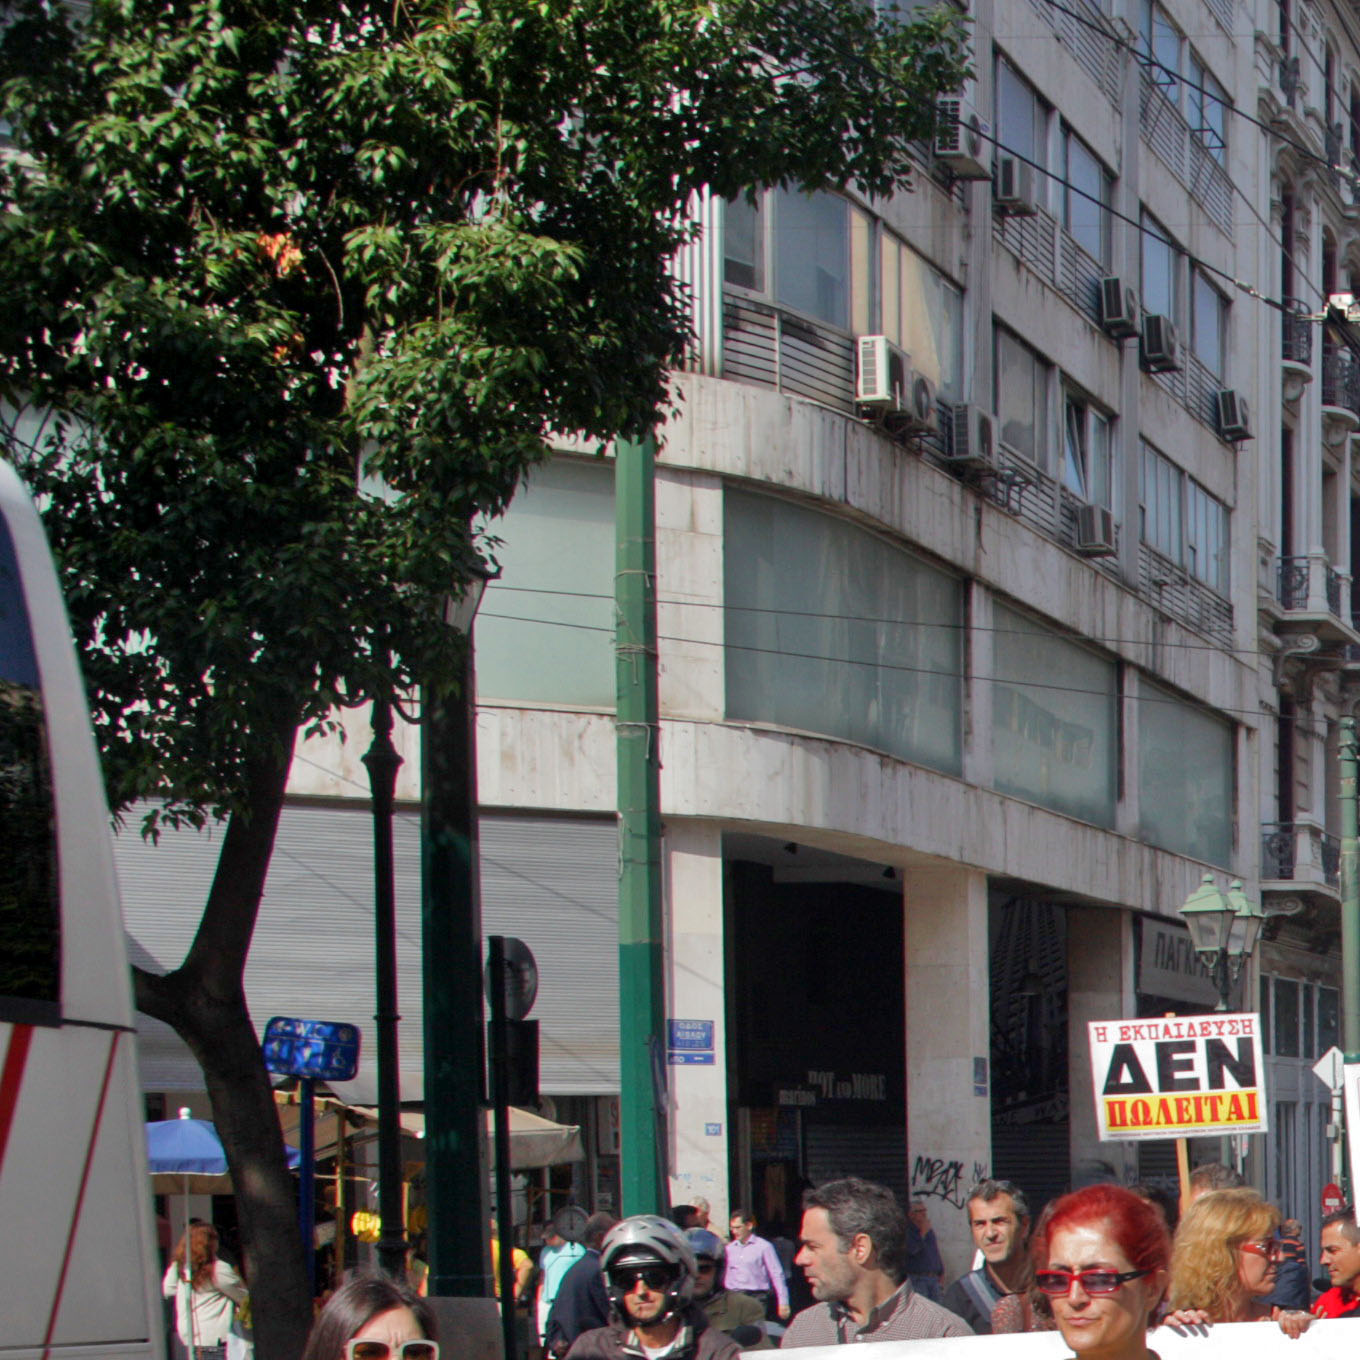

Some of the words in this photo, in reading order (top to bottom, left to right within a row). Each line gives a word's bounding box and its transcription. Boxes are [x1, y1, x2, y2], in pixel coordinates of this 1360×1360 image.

[1094, 1026, 1108, 1042] Η
[1119, 1018, 1254, 1042] ΕΚΠΑΙΔΕΥΣΗ
[1102, 1036, 1257, 1095] ΔΕΝ
[1106, 1093, 1259, 1127] ΠΩΛΕΙΤΑΙ
